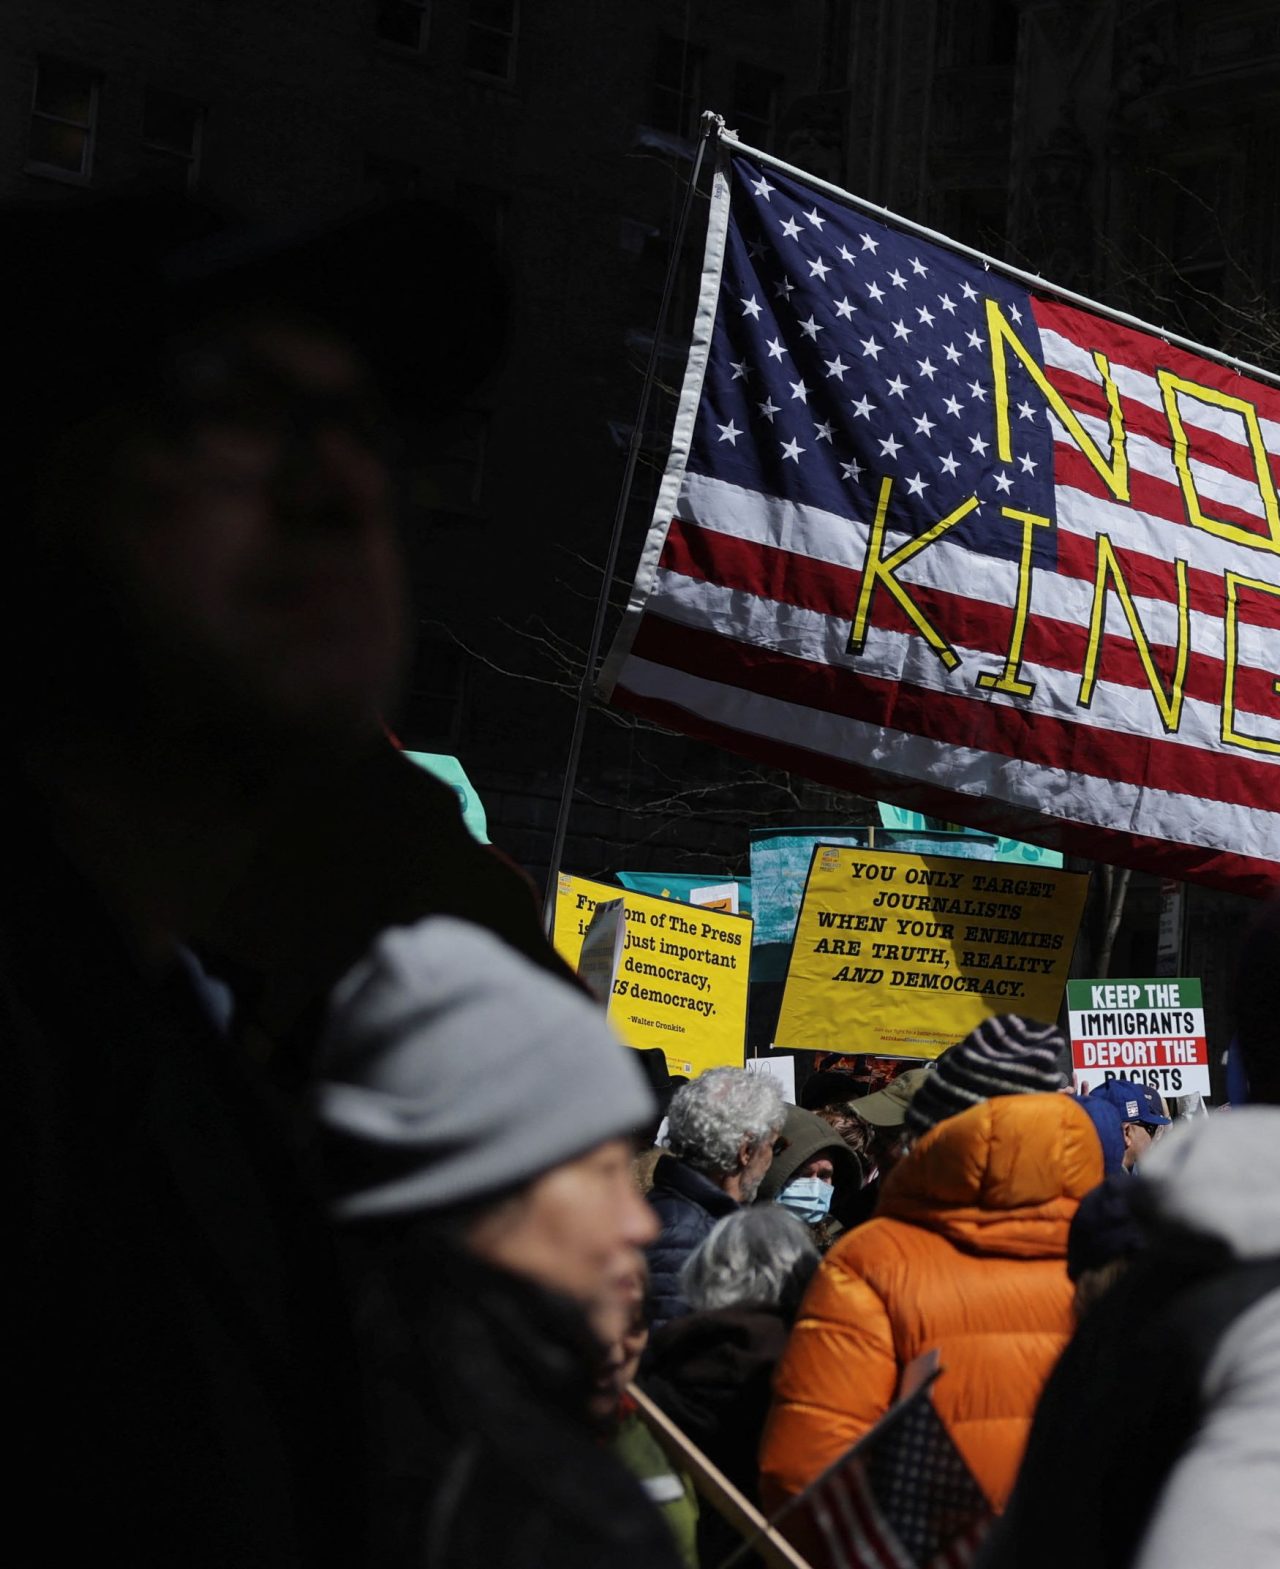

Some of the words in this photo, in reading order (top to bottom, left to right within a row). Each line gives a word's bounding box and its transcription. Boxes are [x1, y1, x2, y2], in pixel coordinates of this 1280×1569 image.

[851, 862, 896, 882] YOU
[905, 868, 964, 889] ONLY
[972, 874, 1056, 899] TARGET
[873, 890, 1022, 921] JOURNALISTS
[650, 913, 668, 928] of
[669, 915, 697, 936] The
[701, 923, 742, 946] Press
[817, 911, 887, 933] WHEN
[897, 919, 954, 940] YOUR
[964, 926, 1063, 950] ENEMIES
[624, 930, 656, 951] just
[660, 938, 737, 969] important
[813, 938, 861, 957] ARE
[872, 943, 950, 969] TRUTH,
[961, 951, 1056, 975] REALITY
[625, 956, 711, 992] democracy,
[832, 966, 884, 985] AND
[890, 970, 1025, 998] DEMOCRACY.
[631, 983, 717, 1017] democracy.
[1091, 985, 1140, 1009] KEEP
[1144, 984, 1181, 1008] THE
[655, 1021, 686, 1034] Cronkite
[1081, 1011, 1195, 1036] IMMIGRANTS
[1083, 1041, 1158, 1066] DEPORT
[1162, 1040, 1198, 1063] THE
